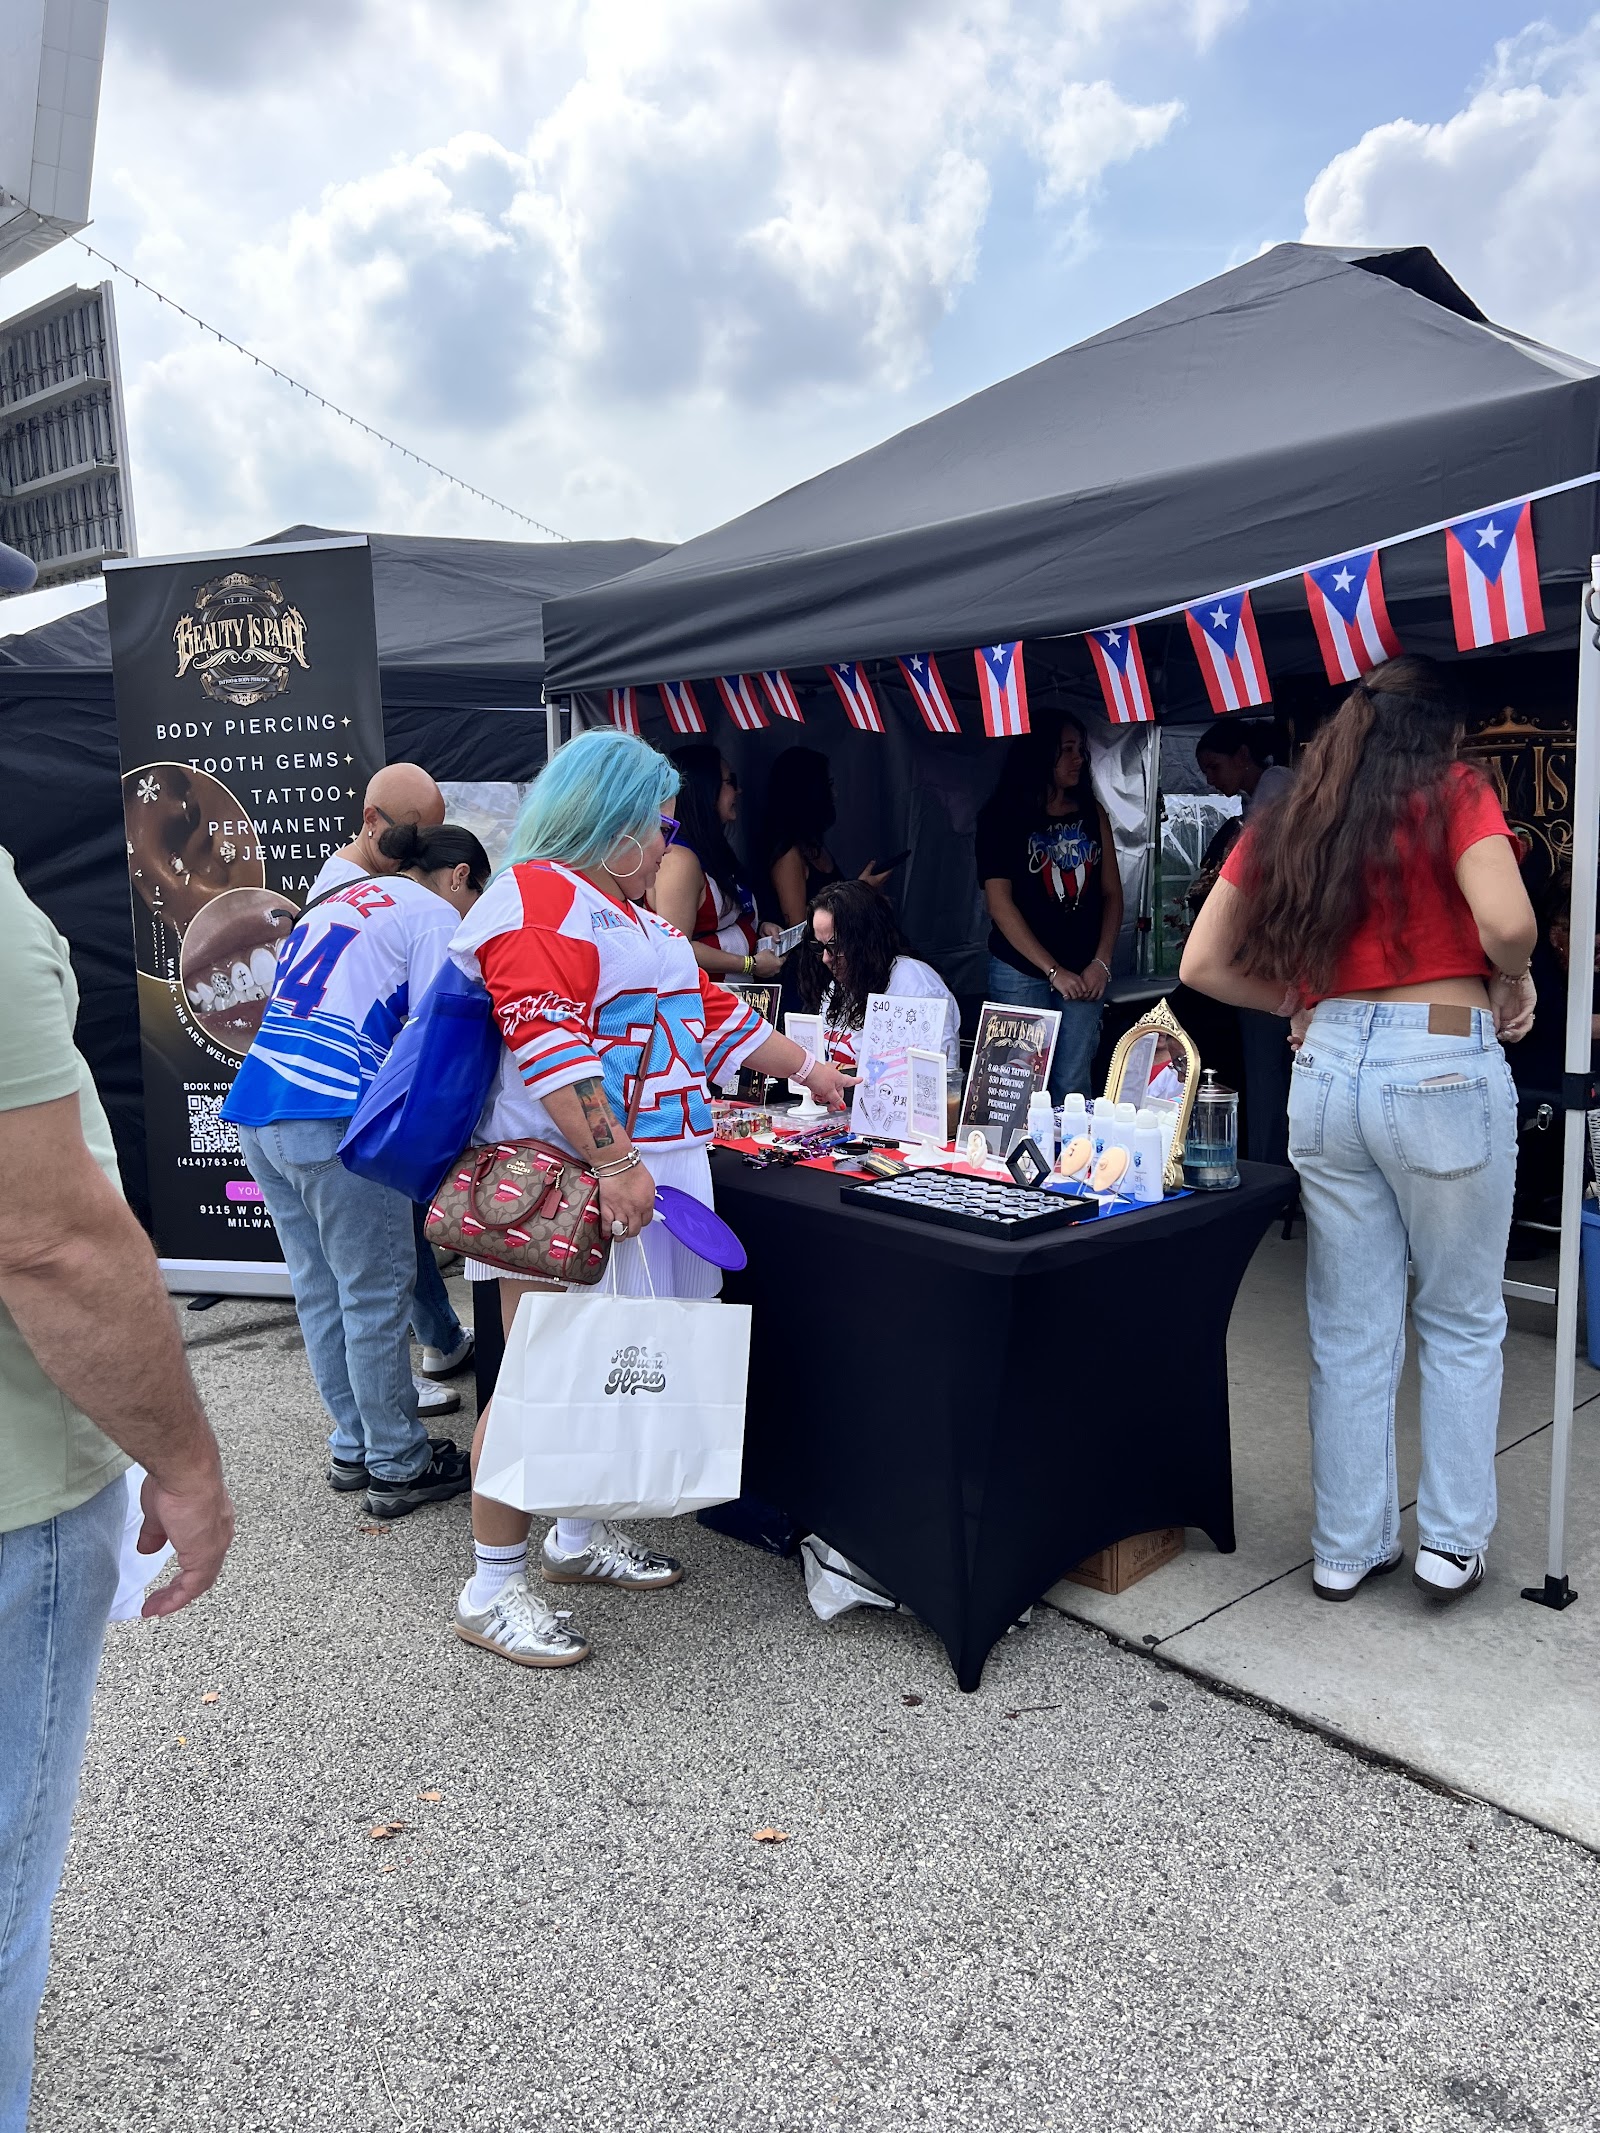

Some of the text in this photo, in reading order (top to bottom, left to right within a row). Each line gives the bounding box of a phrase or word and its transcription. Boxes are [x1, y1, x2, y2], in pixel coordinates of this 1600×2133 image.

[173, 605, 310, 677] BEAUTY IS PAIN
[156, 714, 336, 740] BODY PIERCING
[188, 751, 339, 774] TOOTH GEMS
[1532, 746, 1569, 817] IS
[250, 786, 341, 805] TATTOO
[208, 816, 345, 836] PERMANENT
[281, 875, 318, 890] NA
[167, 957, 178, 993] WALK
[174, 1003, 188, 1025] INS
[185, 1025, 206, 1048] ARE
[205, 1044, 243, 1070] WELCO
[872, 1000, 890, 1013] $40
[982, 1014, 1019, 1050] BEAUTY
[1011, 1067, 1030, 1078] TATTOO
[183, 1082, 210, 1091] BOOK
[177, 1156, 246, 1168] (414)763-00
[506, 1163, 531, 1174] COACH
[200, 1204, 271, 1216] 9115 W OK
[227, 1218, 277, 1229] MILWA
[604, 1368, 666, 1396] Hora
